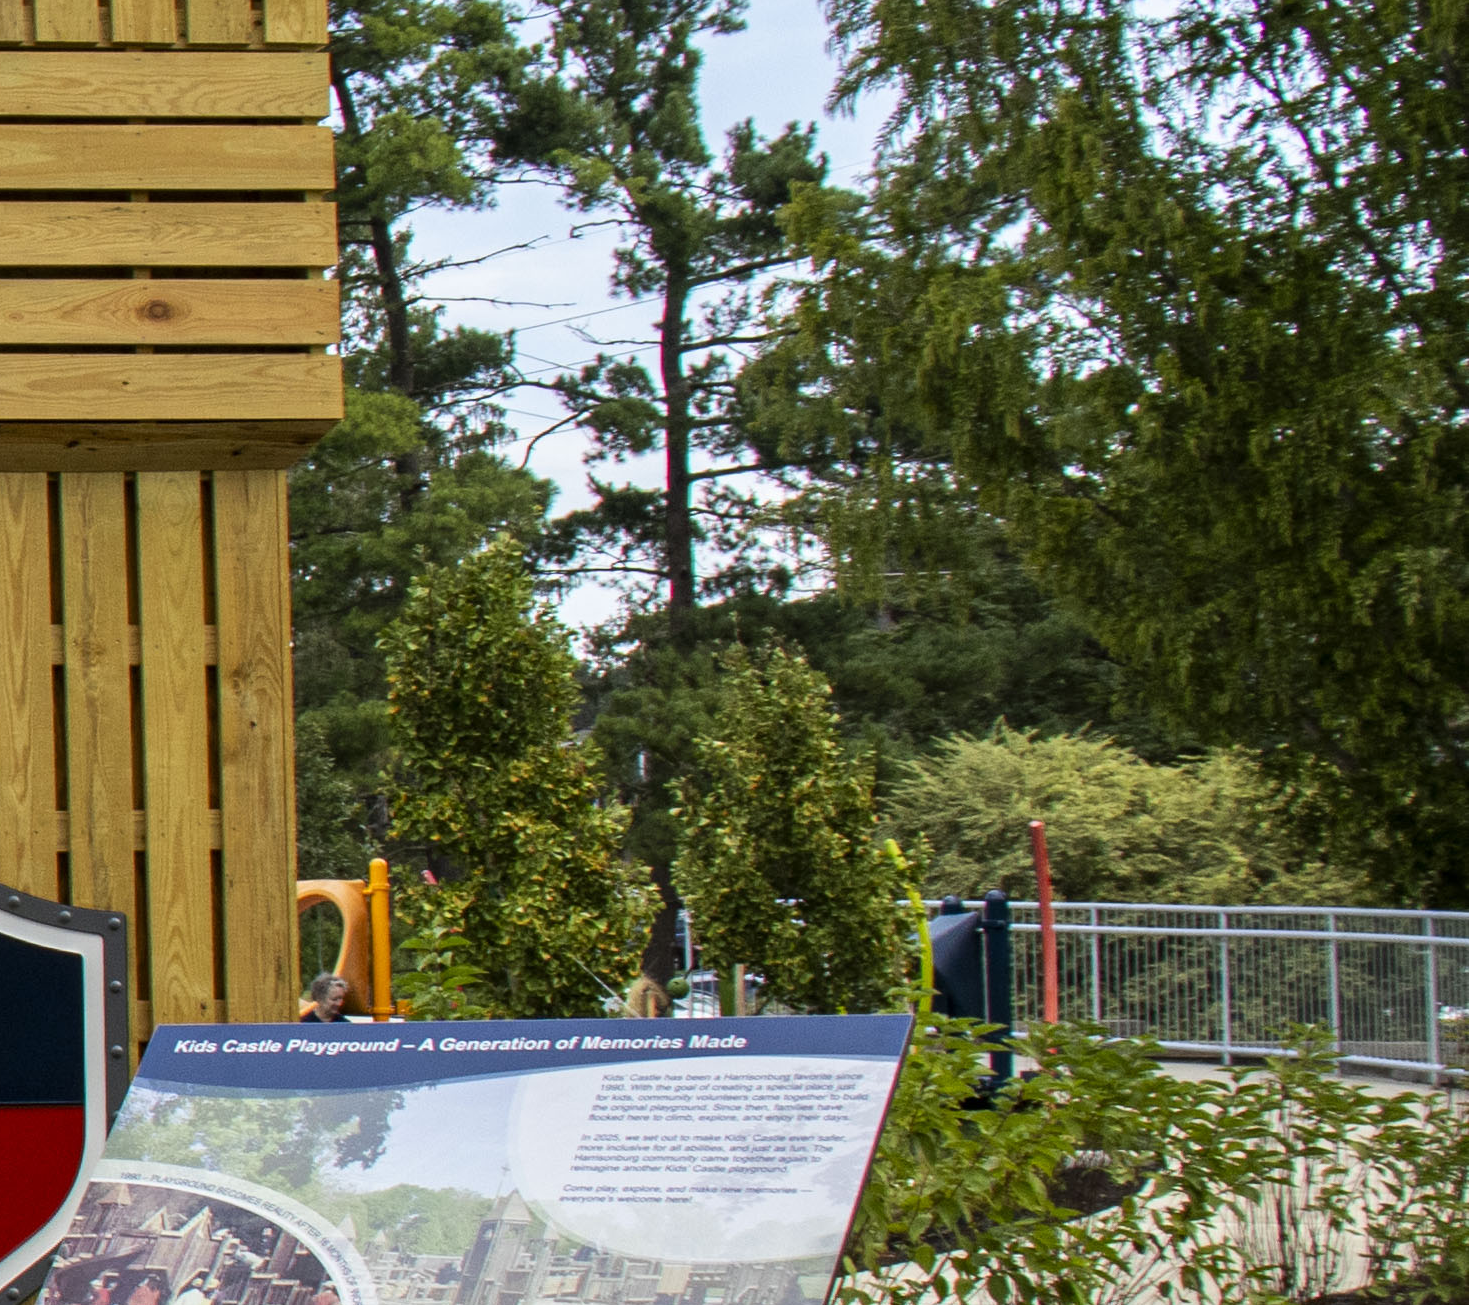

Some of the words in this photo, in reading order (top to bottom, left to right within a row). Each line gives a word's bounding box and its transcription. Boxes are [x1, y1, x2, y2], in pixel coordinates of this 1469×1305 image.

[175, 1039, 217, 1053] Kids
[222, 1039, 282, 1053] Castle
[286, 1038, 400, 1056] Playground
[417, 1038, 435, 1052] A
[439, 1037, 550, 1052] Generation
[555, 1036, 583, 1051] of
[580, 1035, 683, 1050] Memories
[688, 1035, 747, 1049] Made
[724, 1074, 791, 1083] Harrisonburg
[674, 1084, 696, 1093] goal
[712, 1084, 752, 1093] creating
[766, 1084, 803, 1093] special
[804, 1084, 833, 1093] place
[836, 1084, 855, 1093] just
[638, 1094, 691, 1102] community
[783, 1094, 825, 1102] together
[610, 1104, 647, 1112] original
[765, 1115, 793, 1123] enjoy
[751, 1144, 770, 1153] just
[574, 1154, 639, 1163] Harrisonburg
[642, 1154, 697, 1163] community
[733, 1154, 776, 1163] together
[778, 1154, 808, 1163] again
[571, 1164, 619, 1173] reimagine
[622, 1164, 661, 1172] another
[692, 1164, 726, 1172] Castle
[563, 1184, 593, 1192] Come
[666, 1184, 686, 1192] and
[150, 1173, 217, 1192] PLAYGROUND
[216, 1186, 263, 1206] BECOMES
[260, 1200, 298, 1222] REALITY
[295, 1218, 322, 1238] AFTER
[326, 1244, 353, 1276] MONTHS
